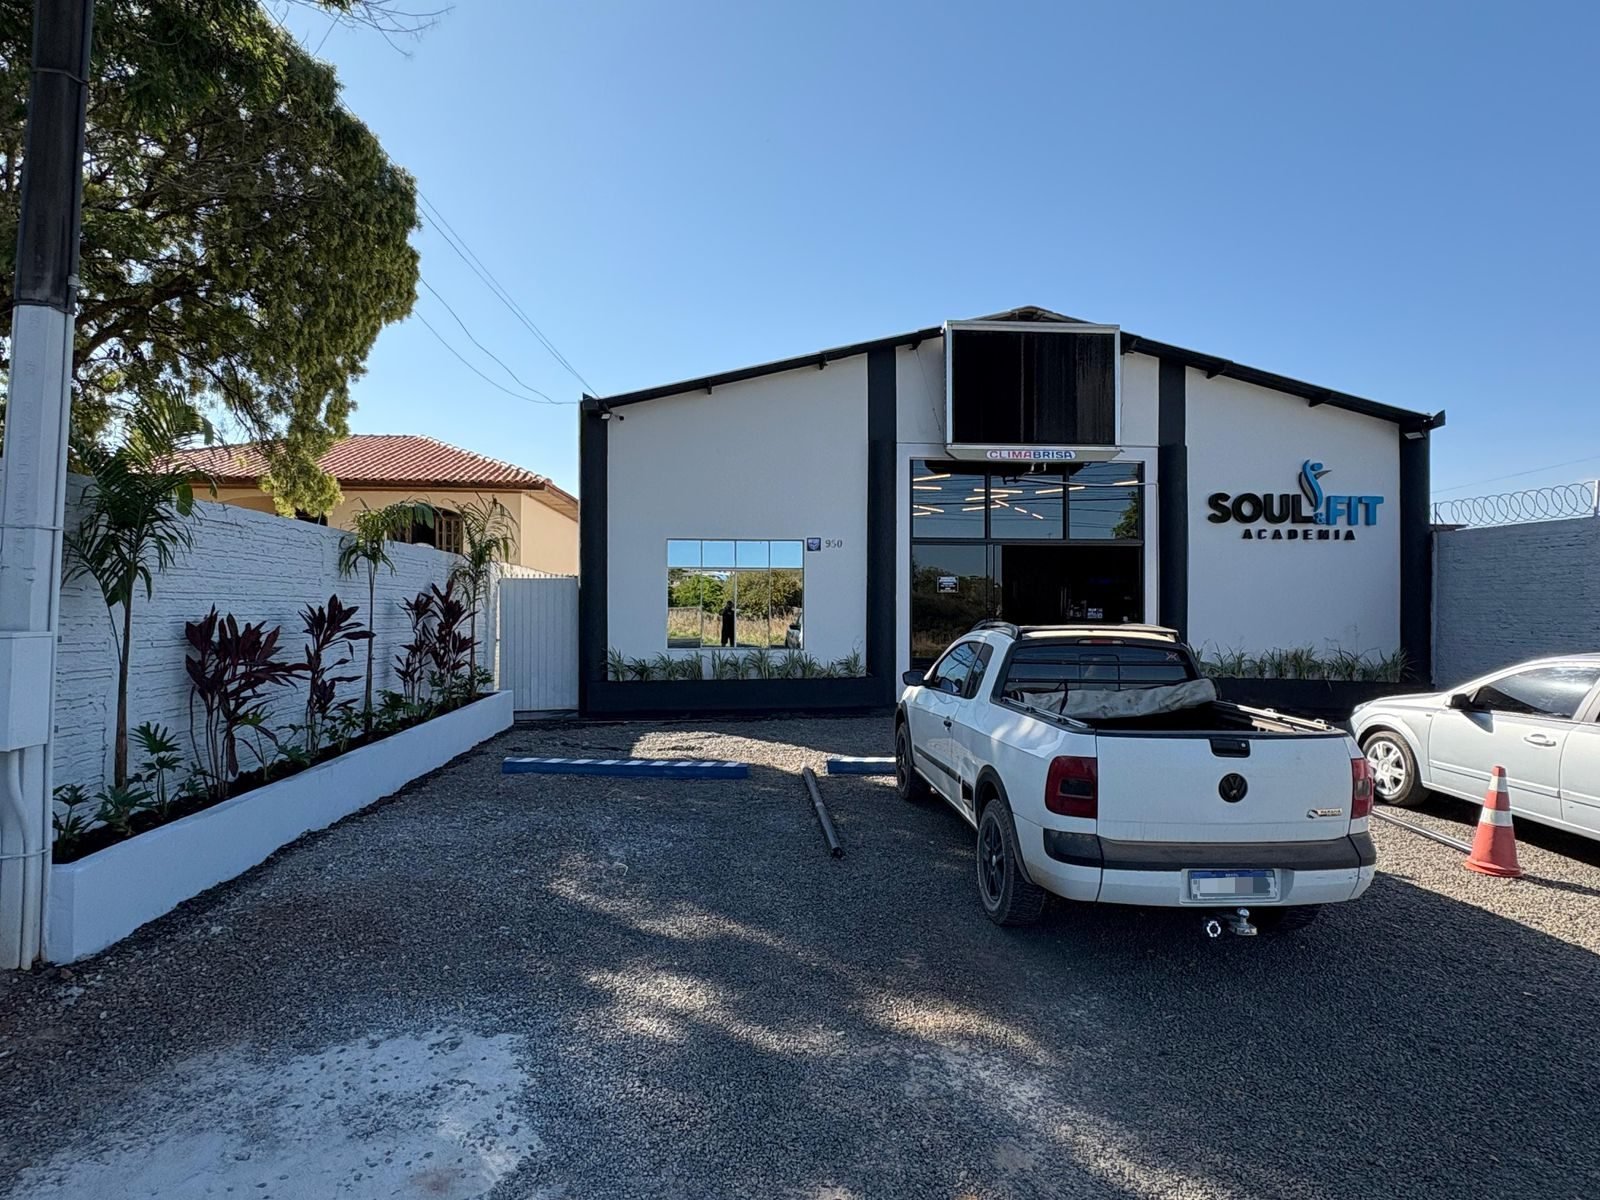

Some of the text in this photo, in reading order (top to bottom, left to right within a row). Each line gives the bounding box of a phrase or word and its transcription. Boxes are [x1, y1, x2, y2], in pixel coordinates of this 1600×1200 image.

[989, 450, 1073, 459] CLIMABRISA
[1207, 492, 1314, 524] SOUL
[1325, 495, 1385, 526] FIT
[1241, 528, 1356, 541] ACADEMIA
[825, 539, 843, 549] 950
